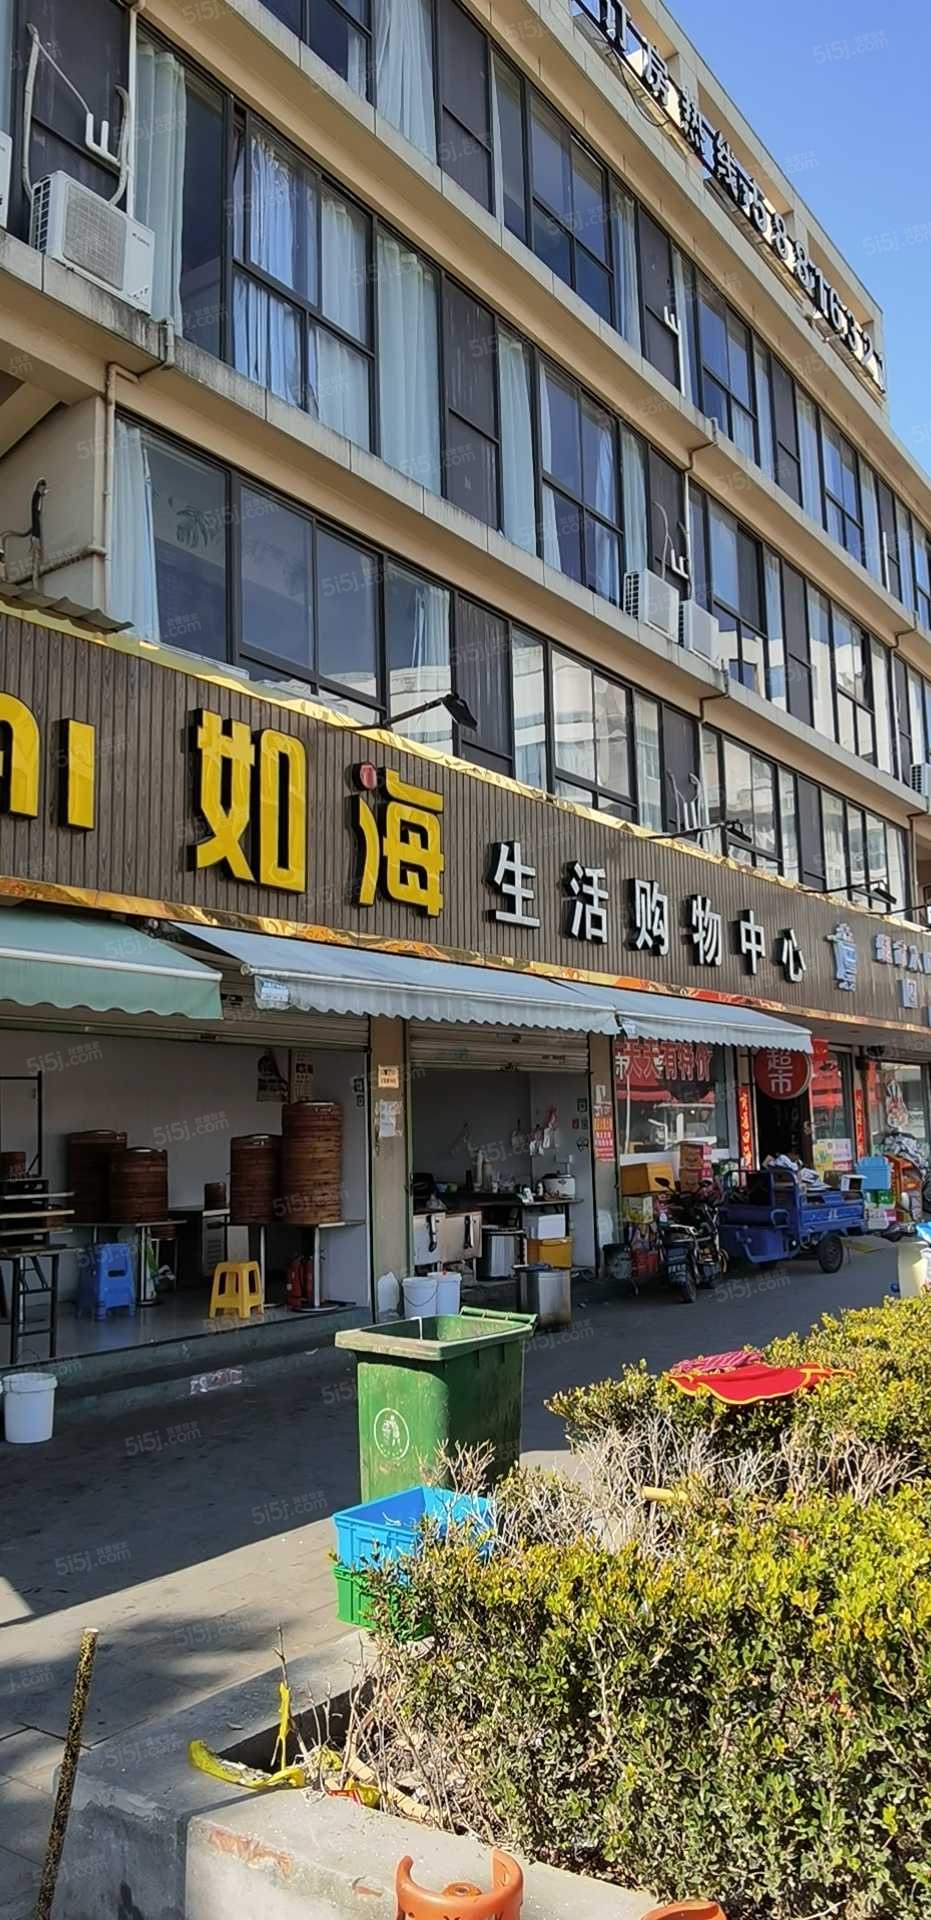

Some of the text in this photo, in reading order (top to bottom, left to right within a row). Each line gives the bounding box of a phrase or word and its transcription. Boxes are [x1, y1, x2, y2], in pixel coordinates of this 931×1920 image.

[190, 708, 807, 984] 如海 生活购物中心
[767, 1049, 793, 1094] 超市
